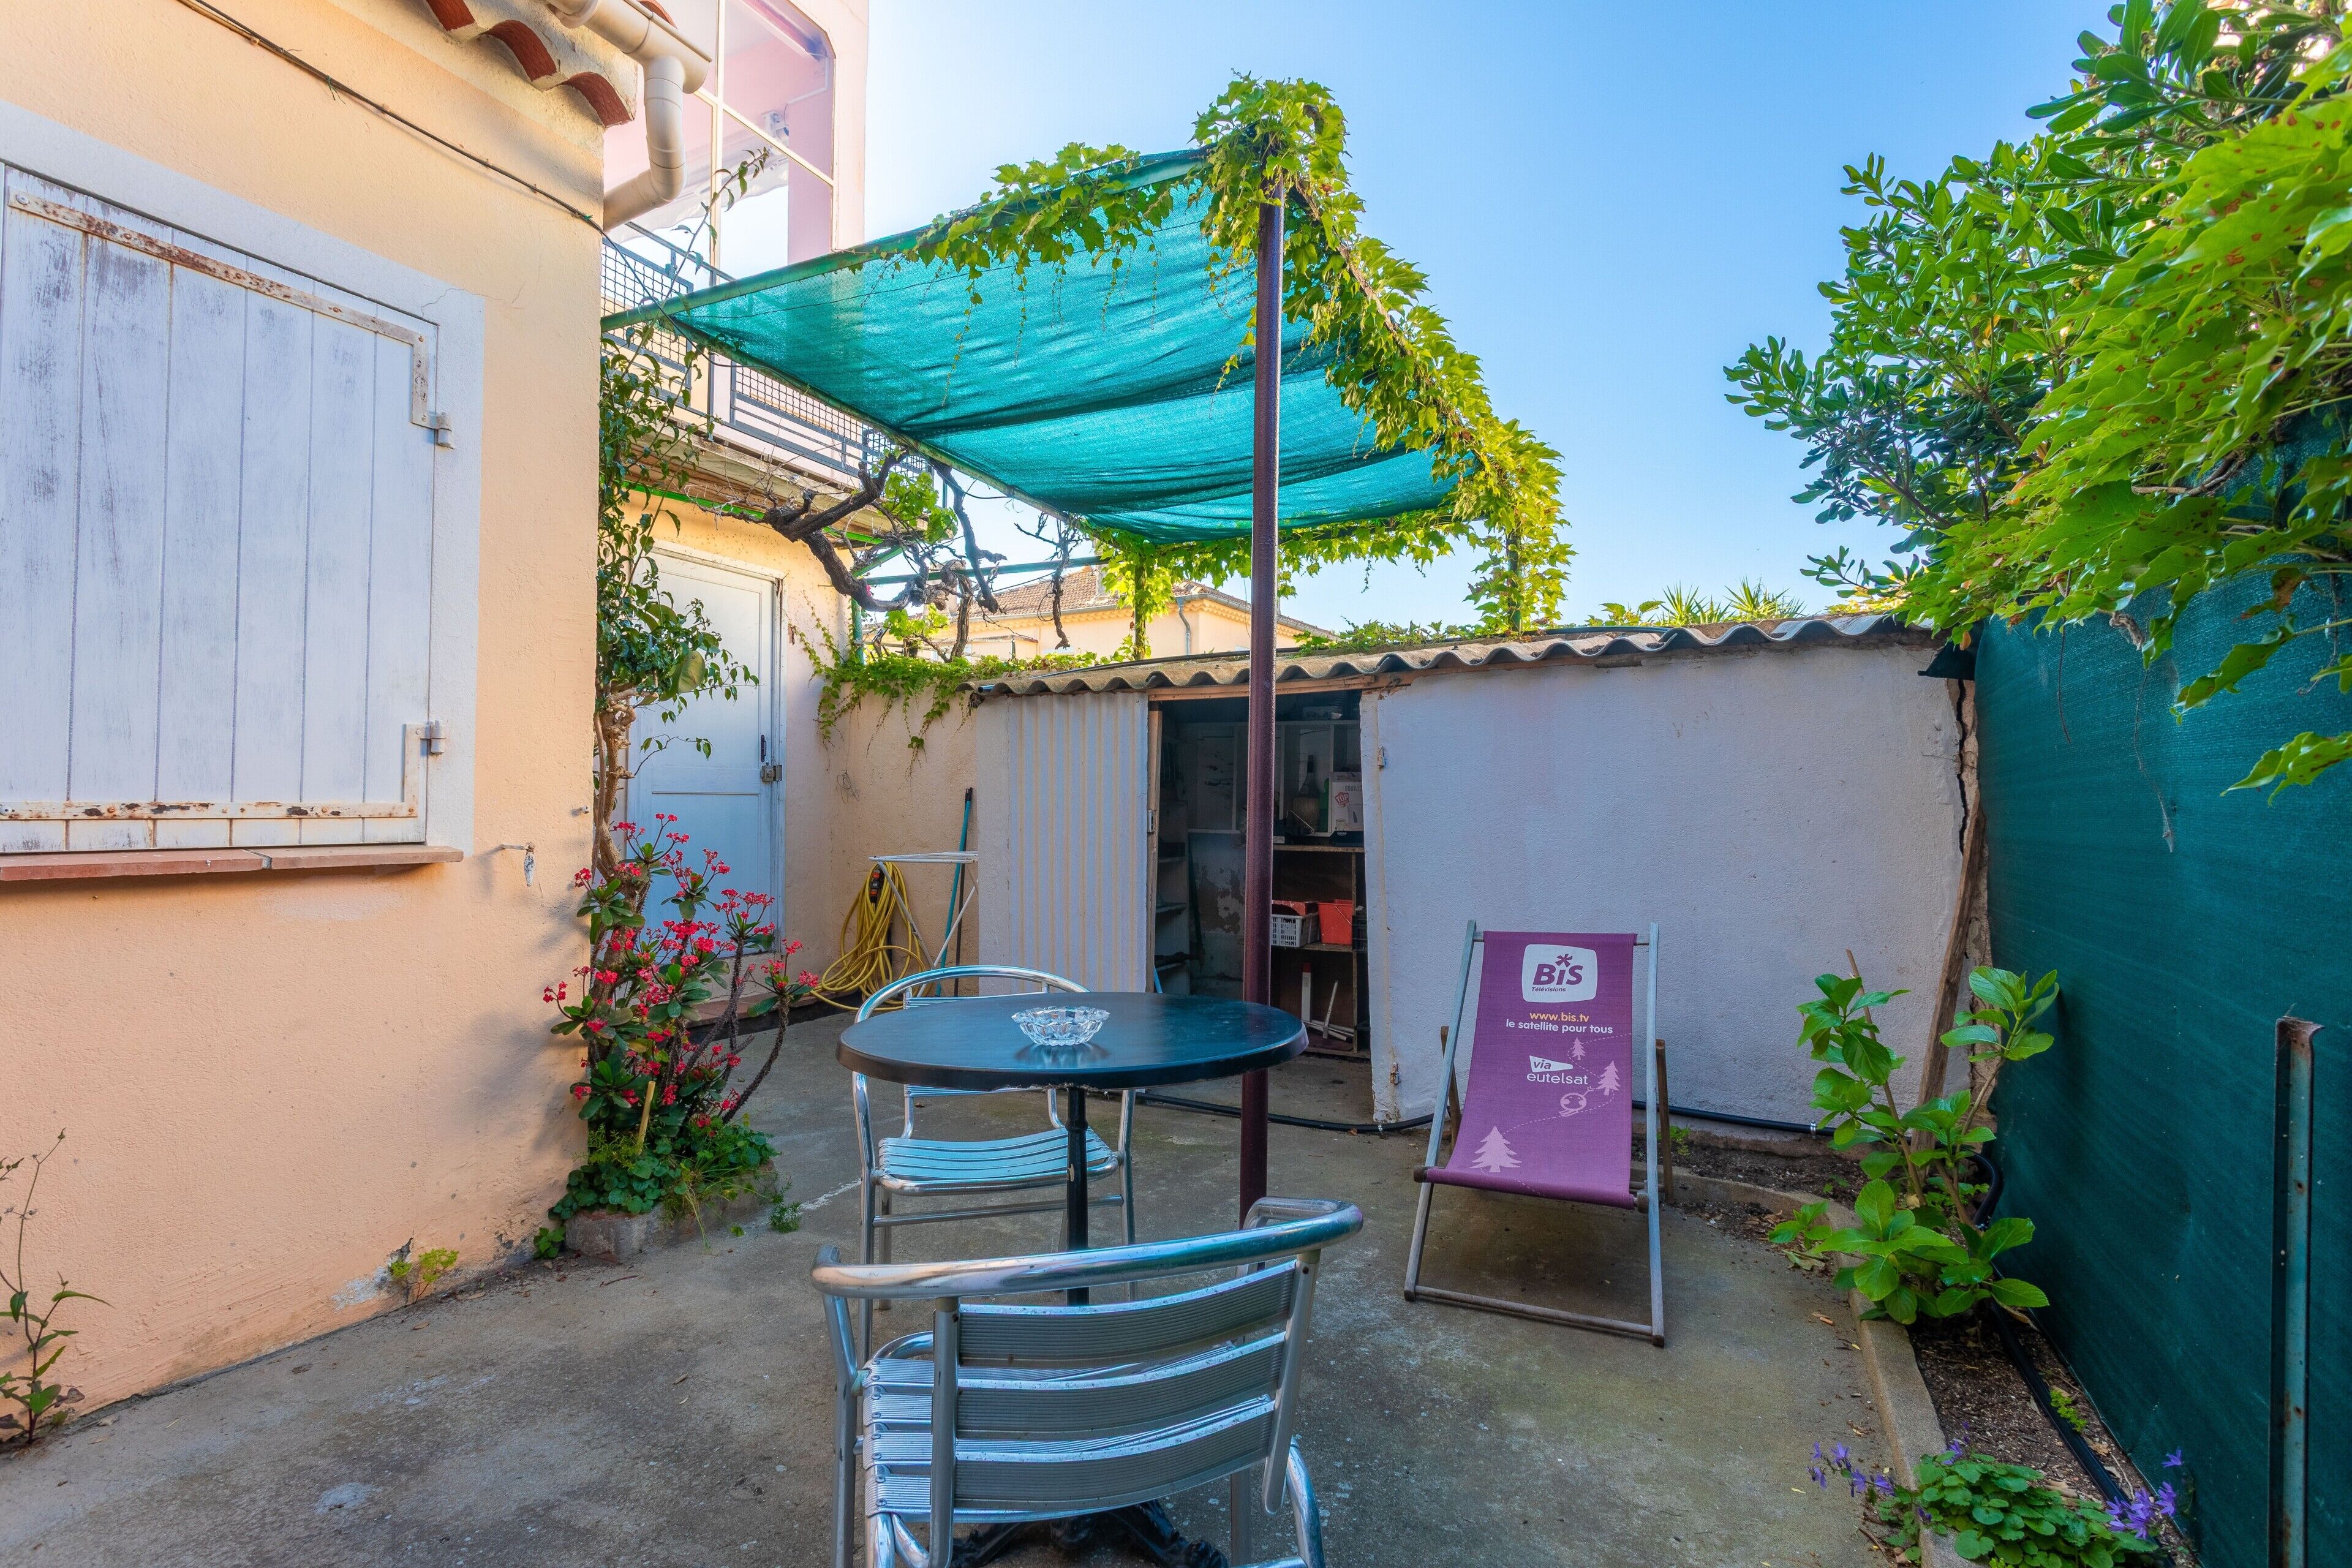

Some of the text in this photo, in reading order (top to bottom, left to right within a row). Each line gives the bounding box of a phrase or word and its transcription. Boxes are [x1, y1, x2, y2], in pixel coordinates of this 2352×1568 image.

[1336, 794, 1349, 803] TOP
[1529, 1012, 1589, 1022] www.bis.tv
[1506, 1019, 1613, 1034] le satellite pour tous
[1534, 1060, 1551, 1069] via
[1526, 1072, 1588, 1085] eutelsat
